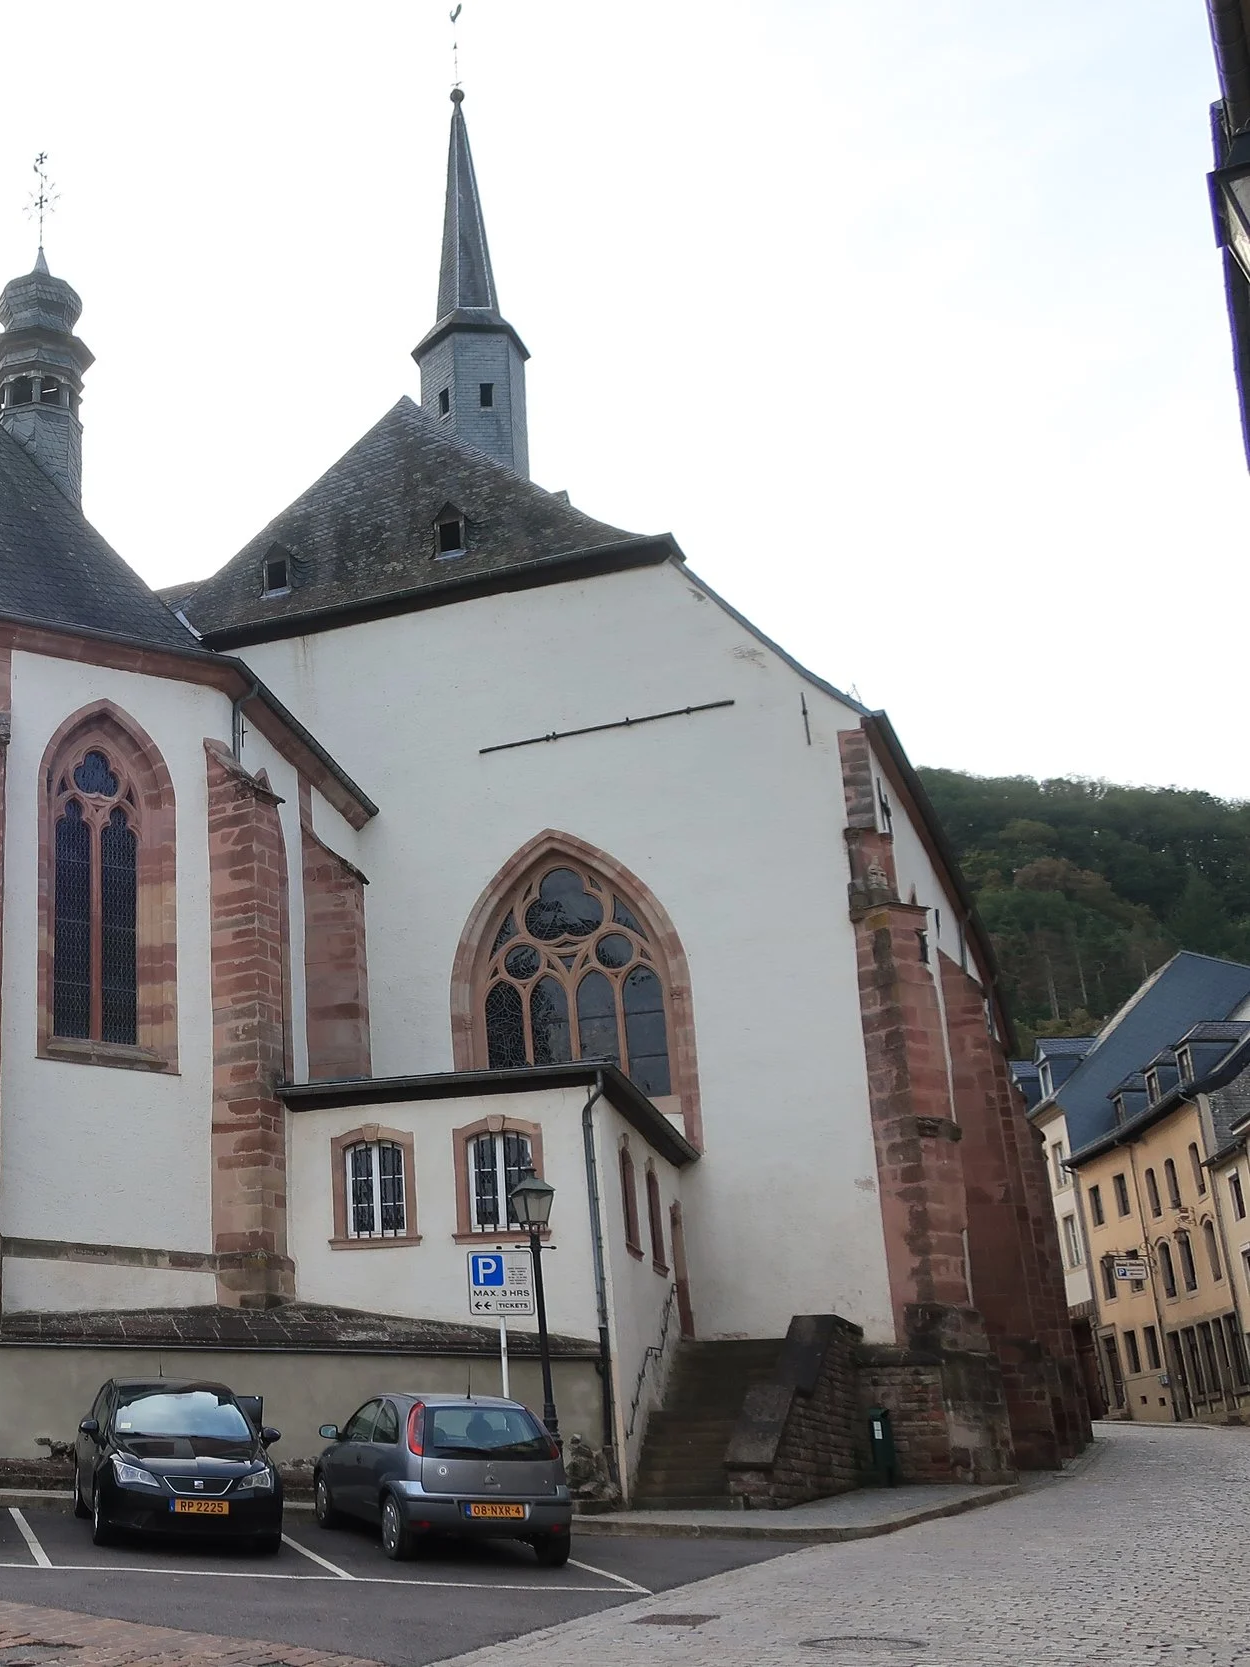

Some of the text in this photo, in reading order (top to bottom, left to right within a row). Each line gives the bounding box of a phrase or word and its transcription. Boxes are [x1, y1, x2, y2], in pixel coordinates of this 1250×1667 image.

[478, 1257, 497, 1284] P
[501, 1289, 507, 1297] 3
[180, 1501, 224, 1513] RP 2225
